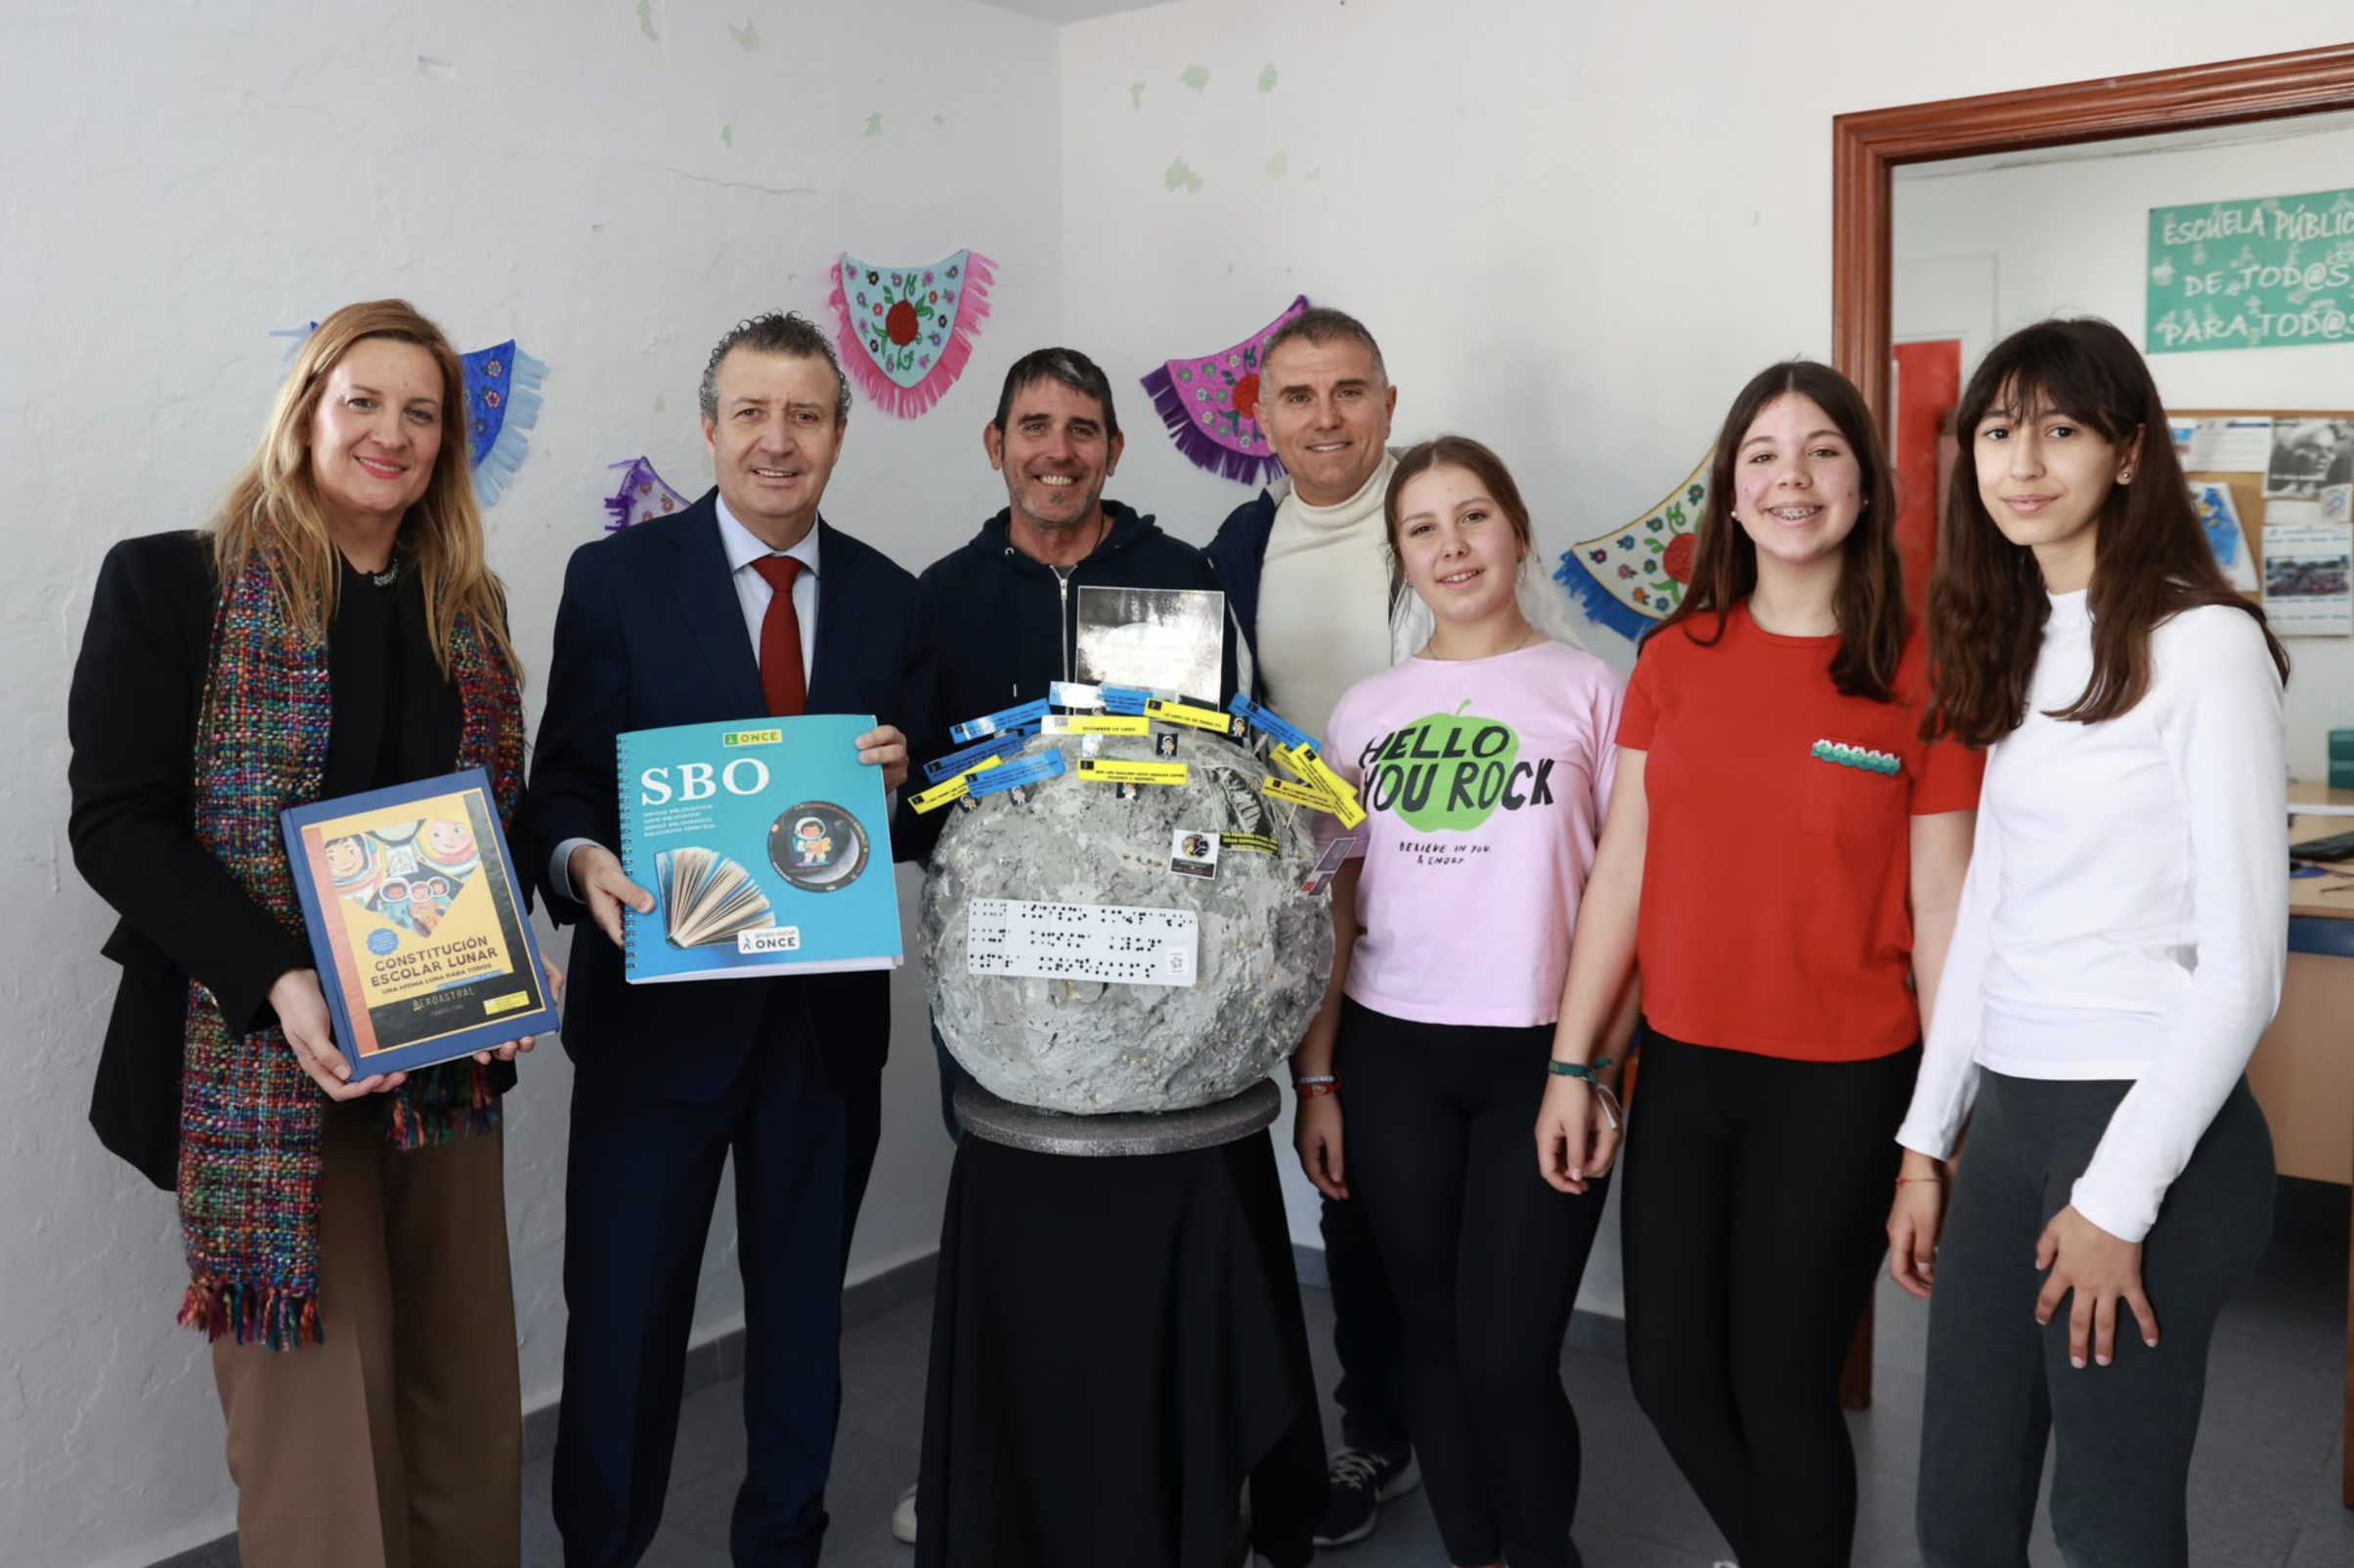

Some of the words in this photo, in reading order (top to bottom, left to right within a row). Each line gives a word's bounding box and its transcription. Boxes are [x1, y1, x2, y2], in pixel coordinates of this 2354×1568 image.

[2163, 206, 2266, 245] ESCUELA
[2183, 271, 2224, 296] DE
[2239, 263, 2350, 291] TOD@S
[2158, 314, 2248, 346] PARA
[740, 732, 777, 743] ONCE
[1359, 724, 1510, 769] HELLO
[640, 758, 769, 806] SBO
[1363, 762, 1439, 813] YOU
[1446, 758, 1554, 812] ROCK
[1399, 841, 1447, 853] BELIEVE
[1427, 856, 1464, 865] ENJOY
[374, 936, 488, 972] CONSTITUCIÓN
[756, 936, 796, 949] ONCE
[371, 961, 442, 987] ESCOLAR
[448, 947, 499, 969] LUNAR
[381, 984, 398, 994] UNA
[399, 980, 423, 990] MISMA
[424, 976, 445, 985] LUNA
[446, 970, 466, 980] PARA
[467, 963, 492, 974] TODOS
